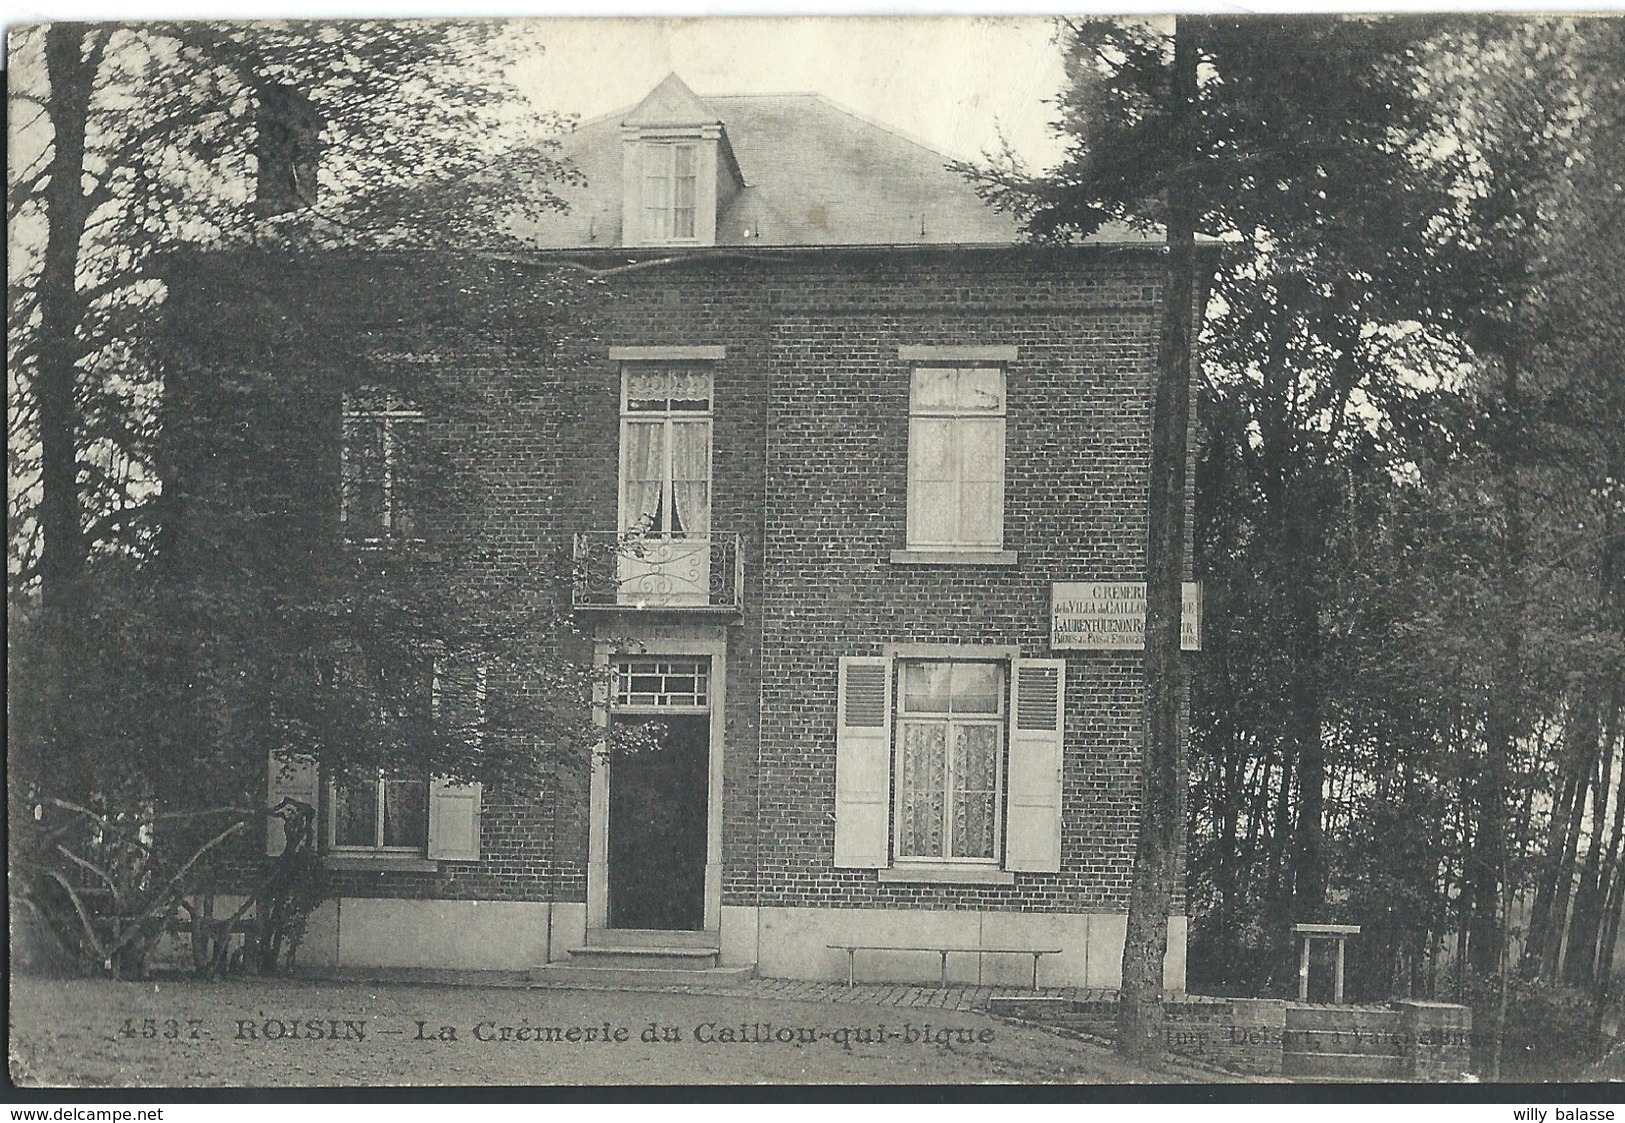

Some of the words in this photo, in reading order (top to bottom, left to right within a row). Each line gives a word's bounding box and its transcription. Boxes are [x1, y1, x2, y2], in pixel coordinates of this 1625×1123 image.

[1092, 586, 1145, 600] CREMERI
[1068, 600, 1096, 613] VILLA
[1106, 600, 1146, 614] CAILLO
